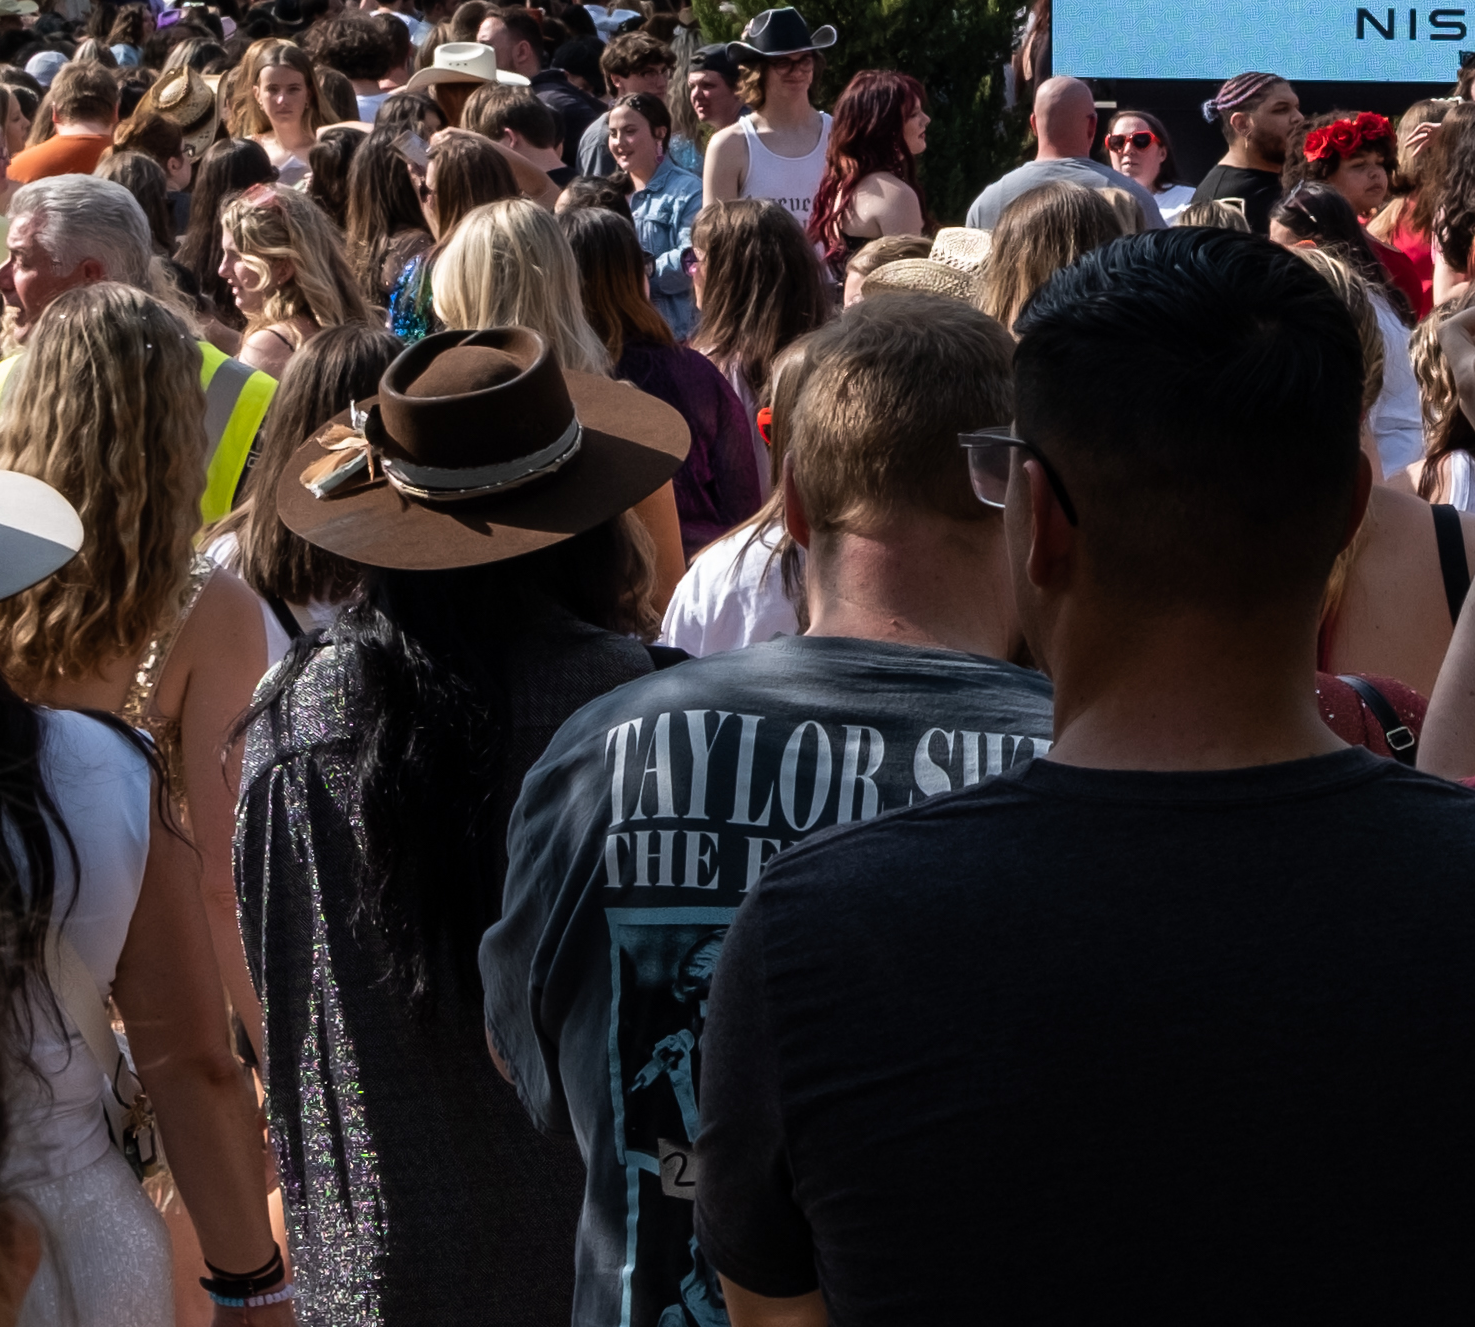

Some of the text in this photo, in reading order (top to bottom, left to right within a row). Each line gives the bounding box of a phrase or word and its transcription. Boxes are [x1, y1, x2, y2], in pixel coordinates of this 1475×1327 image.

[604, 709, 1054, 831] TAYLOR SW
[605, 830, 720, 890] THE
